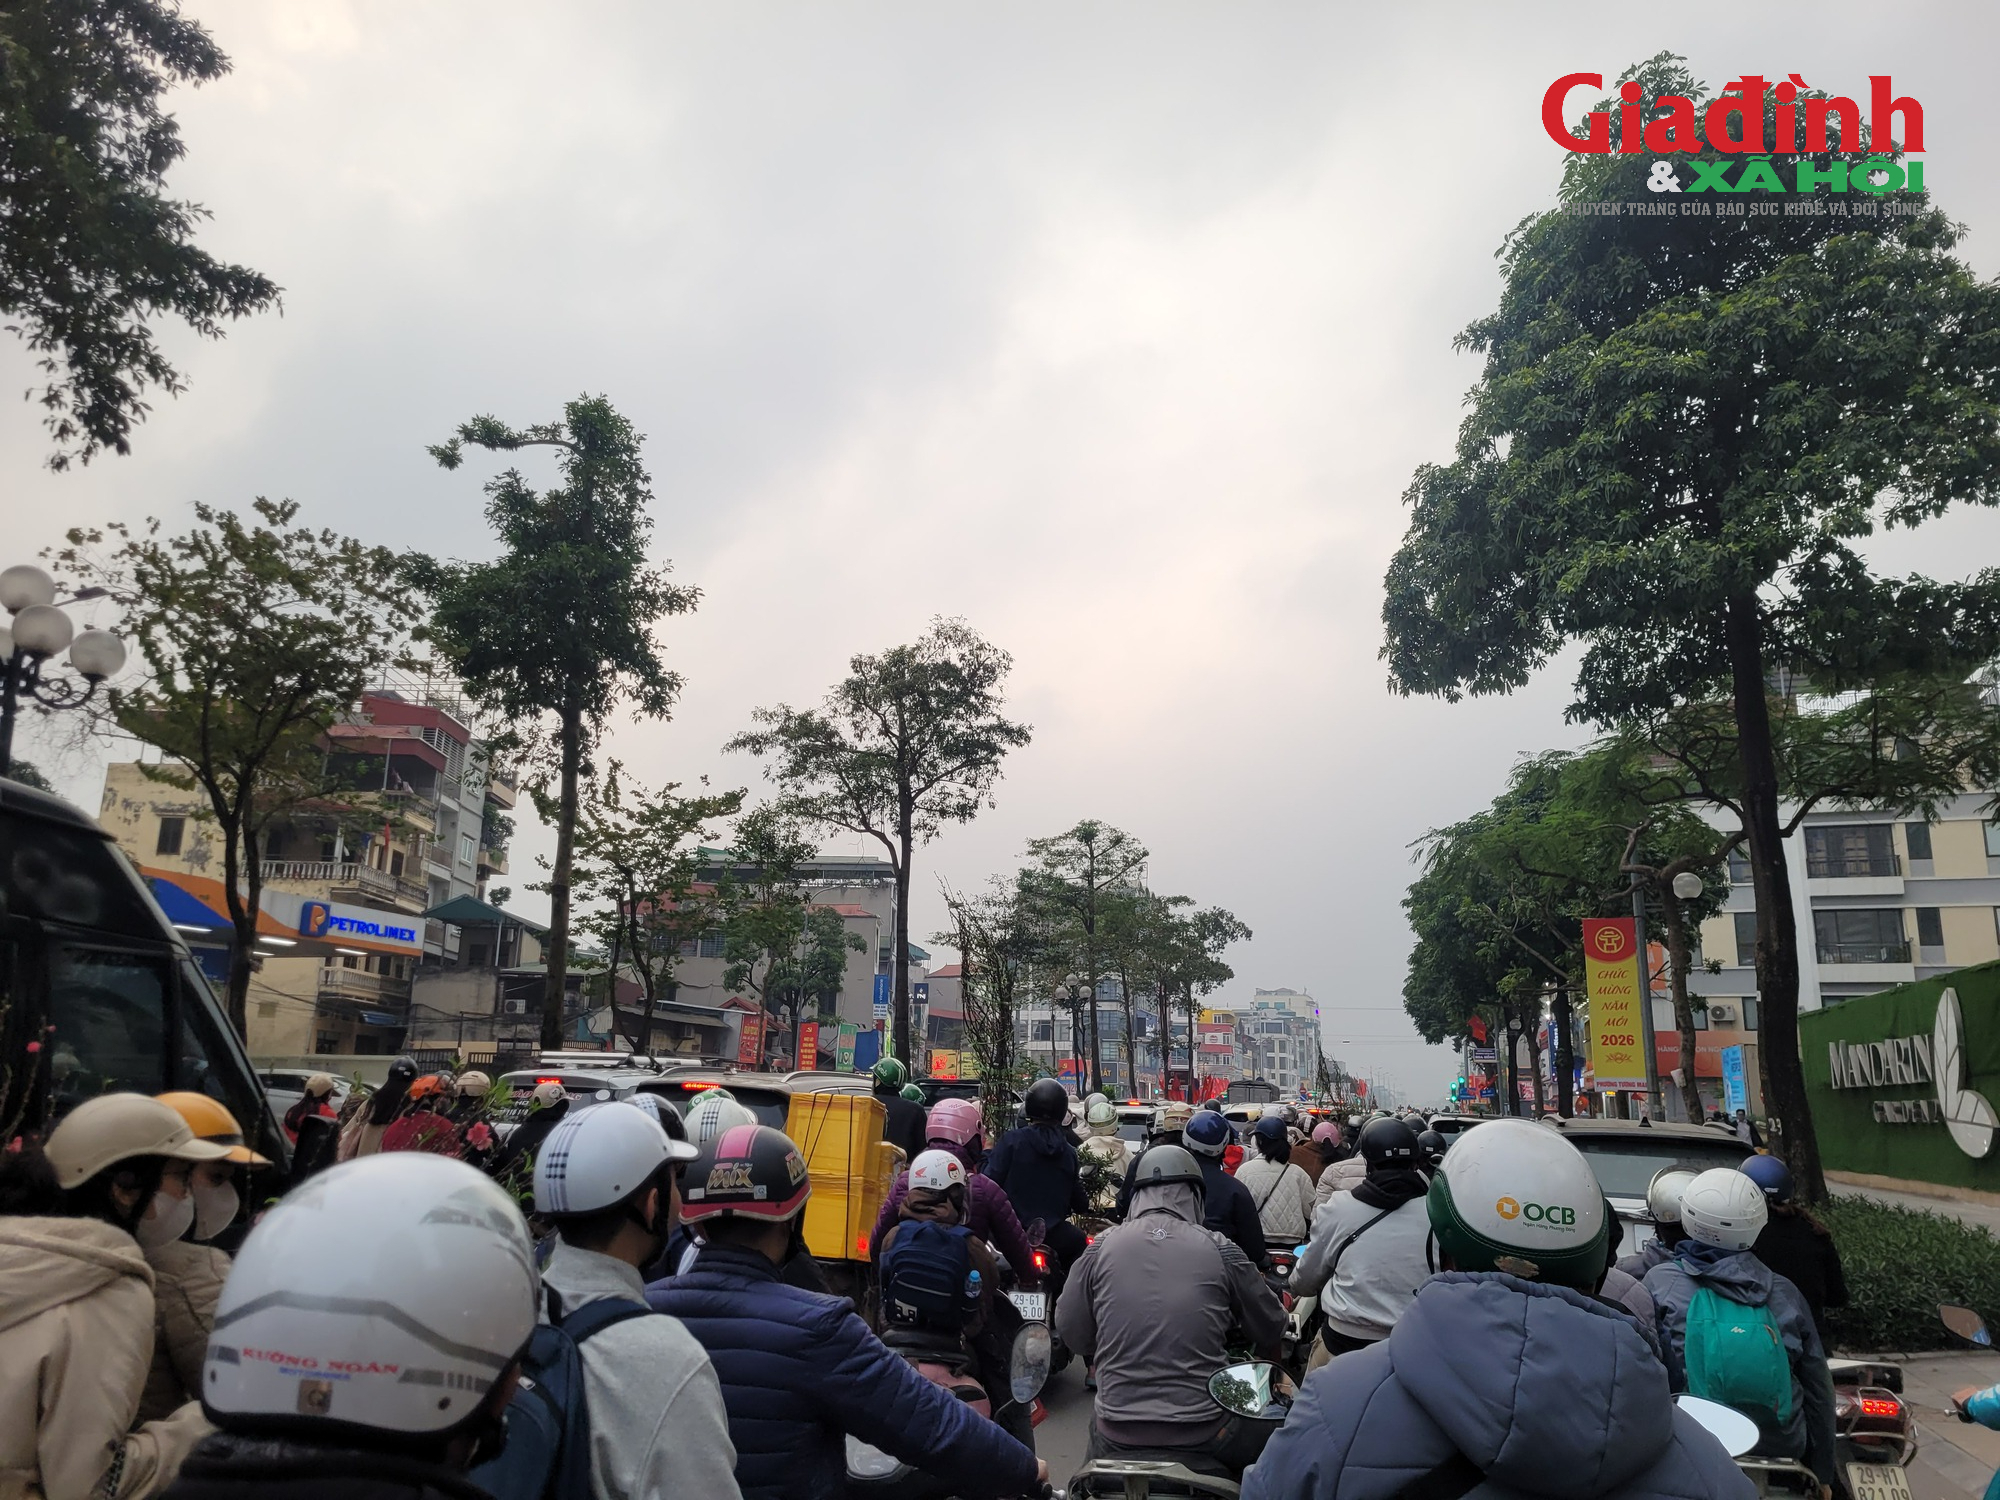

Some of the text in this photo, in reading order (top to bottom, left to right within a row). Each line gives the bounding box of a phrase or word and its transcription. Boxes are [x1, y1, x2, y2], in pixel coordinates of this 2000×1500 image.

[328, 916, 416, 942] PETROLIMEX
[1597, 968, 1629, 979] CHÚC
[1601, 1000, 1629, 1011] NĂM
[1601, 1034, 1635, 1046] 2026
[1829, 1034, 1932, 1089] MANDARIN
[1873, 1101, 1930, 1124] GARDEN
[1523, 1203, 1576, 1225] OCB
[1014, 1294, 1040, 1306] 29-G1
[1019, 1307, 1042, 1318] 5.00
[1857, 1466, 1900, 1486] 29-H1
